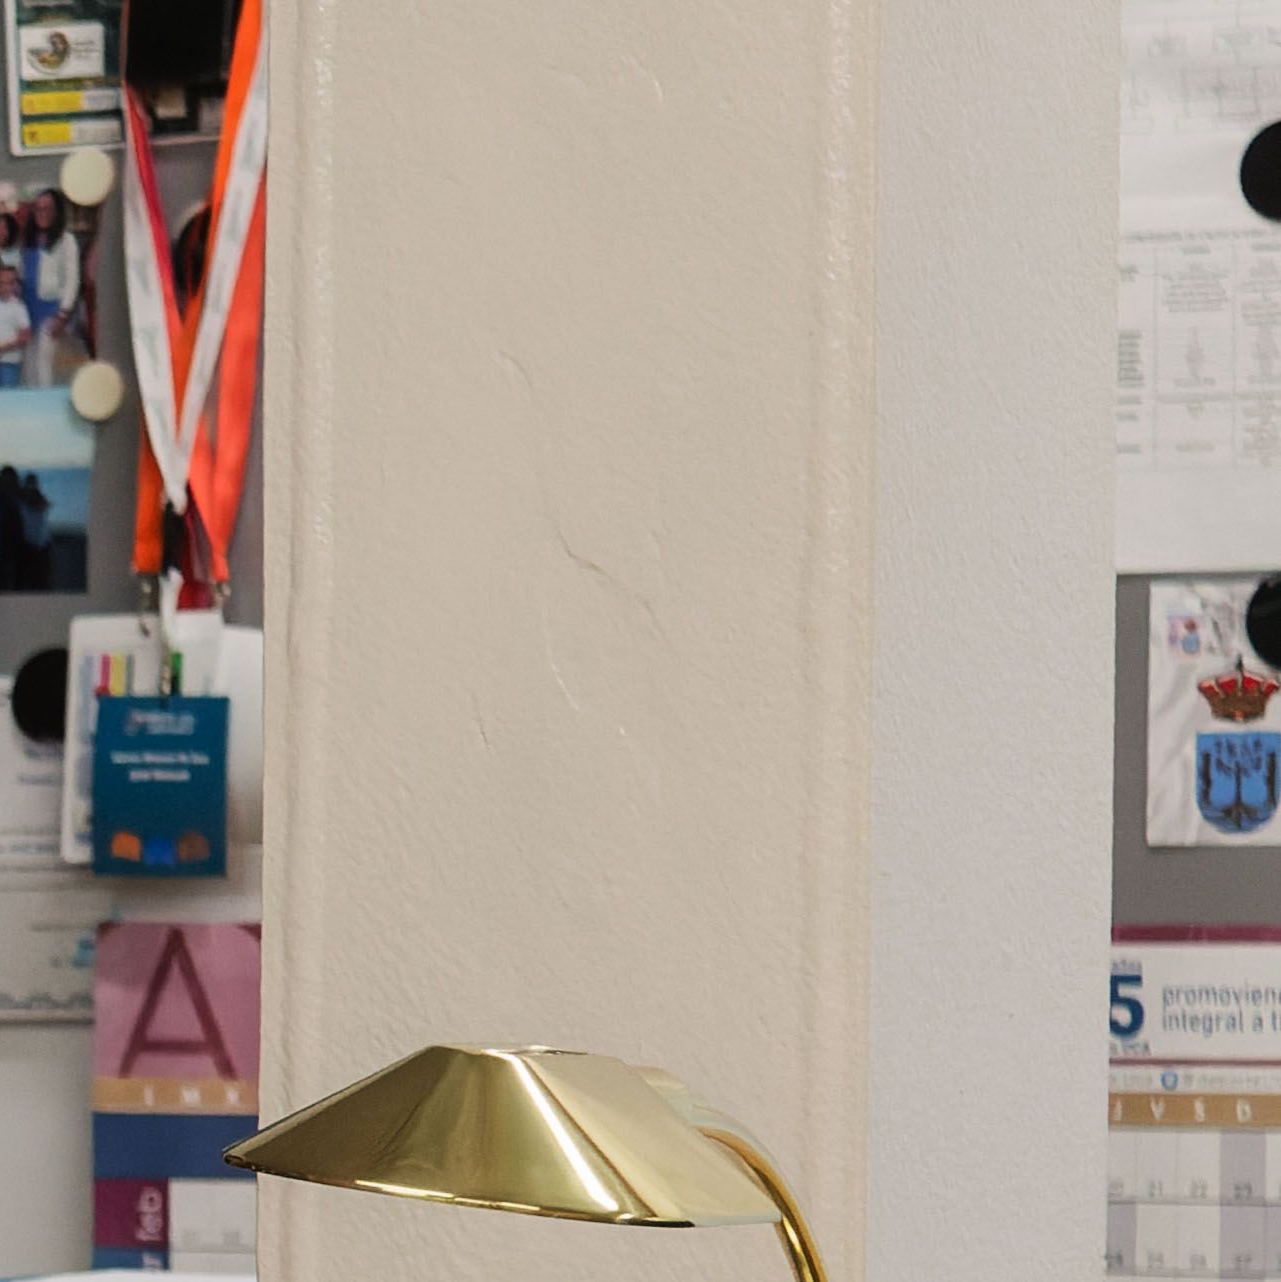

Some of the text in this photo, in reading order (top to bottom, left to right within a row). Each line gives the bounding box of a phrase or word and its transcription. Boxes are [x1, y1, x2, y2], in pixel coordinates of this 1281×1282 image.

[1162, 979, 1281, 1007] promovien
[1162, 1007, 1245, 1038] integral
[1271, 1008, 1281, 1034] t
[1149, 1097, 1166, 1121] V
